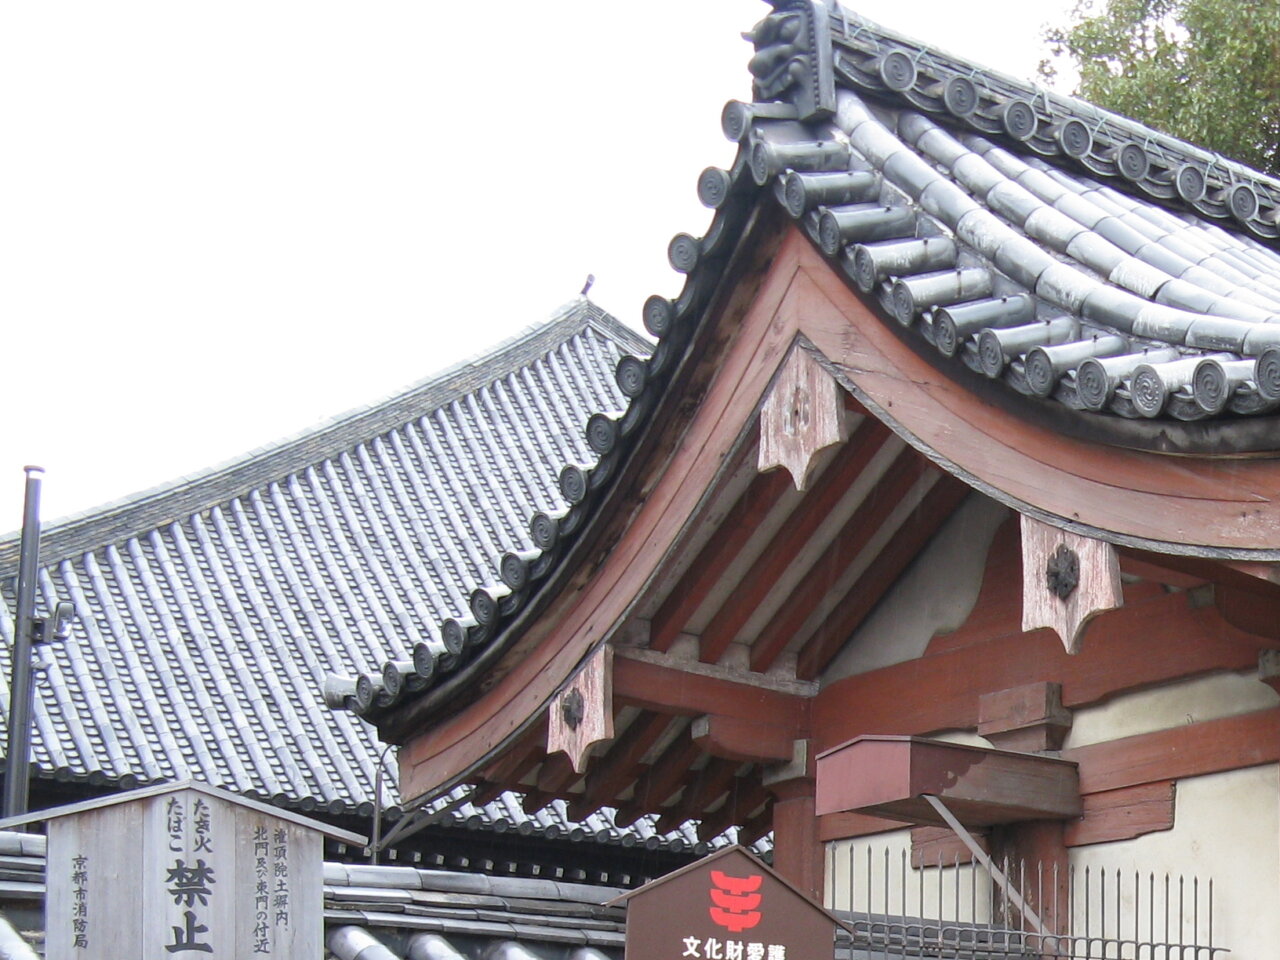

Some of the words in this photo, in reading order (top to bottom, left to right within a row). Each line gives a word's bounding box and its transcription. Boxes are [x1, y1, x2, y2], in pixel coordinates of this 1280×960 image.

[167, 796, 185, 853] たばこ
[193, 798, 213, 854] たき火
[71, 854, 89, 950] 京都市消防局
[164, 858, 217, 954] 禁止
[253, 825, 271, 954] 北門及び東門の付近
